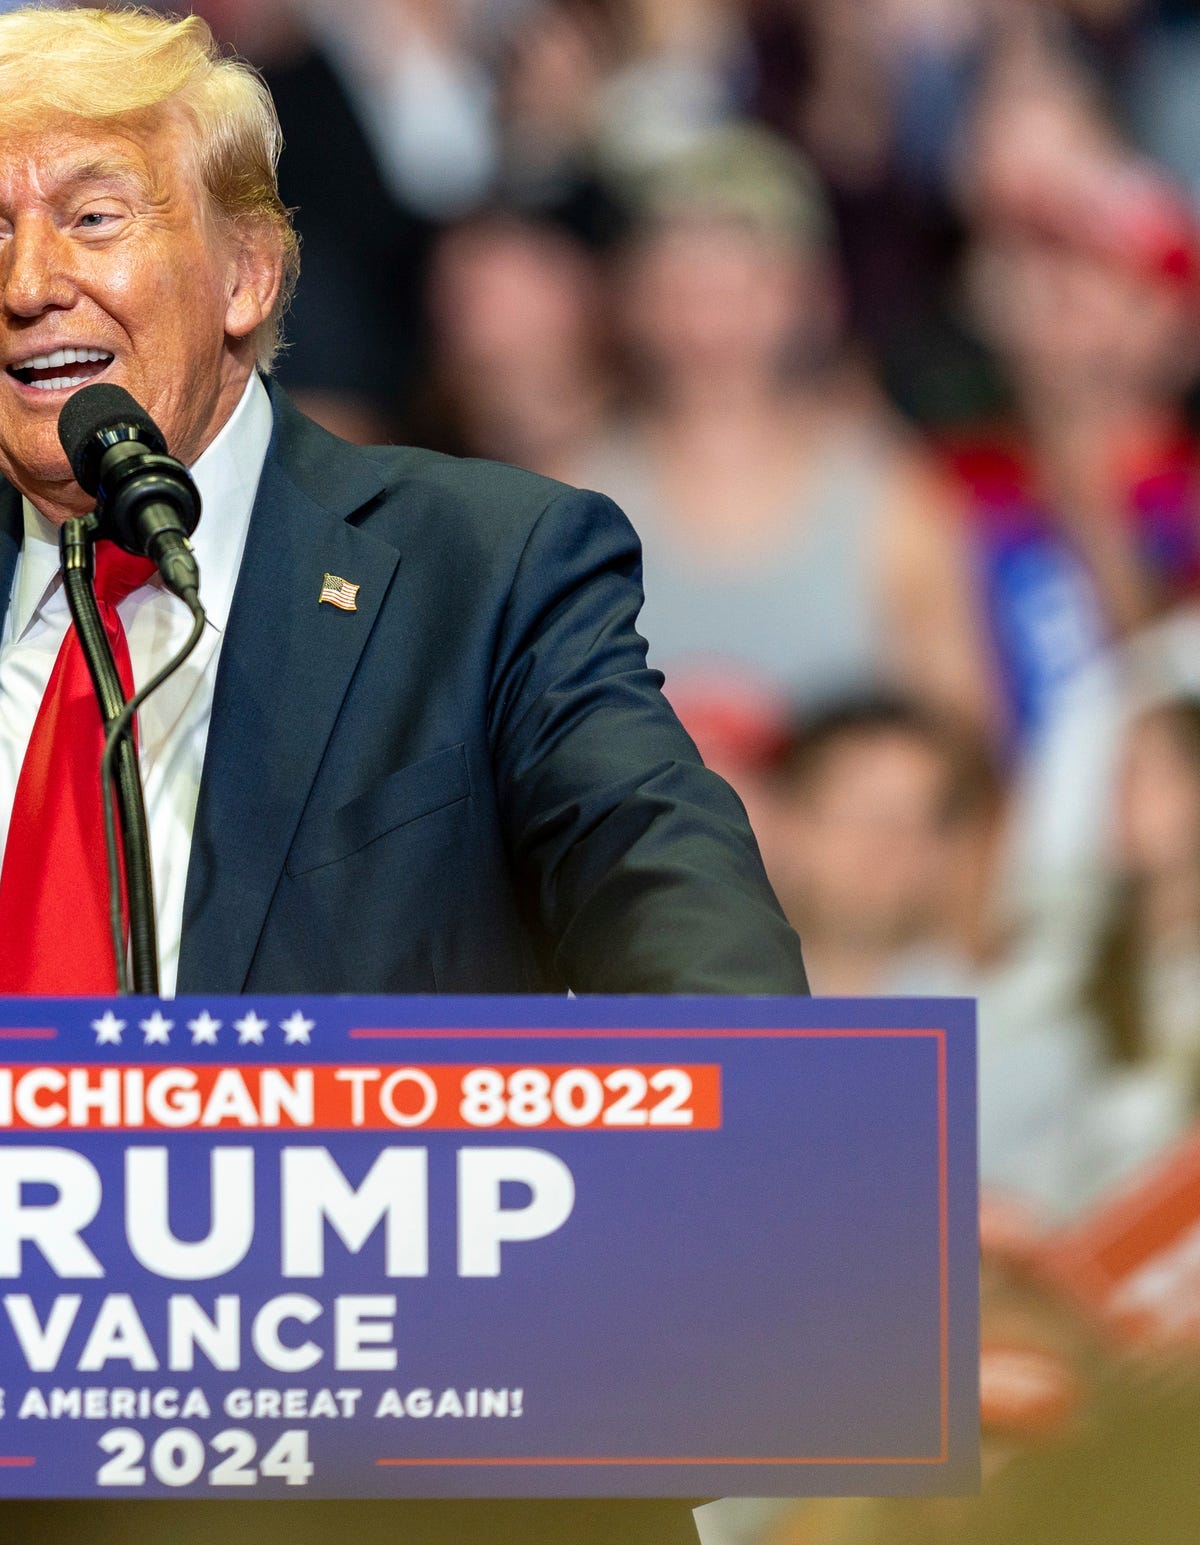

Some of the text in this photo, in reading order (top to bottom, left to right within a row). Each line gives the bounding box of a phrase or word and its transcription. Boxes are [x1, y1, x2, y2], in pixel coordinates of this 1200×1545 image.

[334, 1068, 438, 1127] TO
[459, 1068, 694, 1127] 88022
[3, 1293, 398, 1373] VANCE
[18, 1387, 211, 1419] AMERICA
[224, 1388, 363, 1419] GREAT
[375, 1388, 524, 1419] AGAIN!
[97, 1427, 314, 1487] 2024
